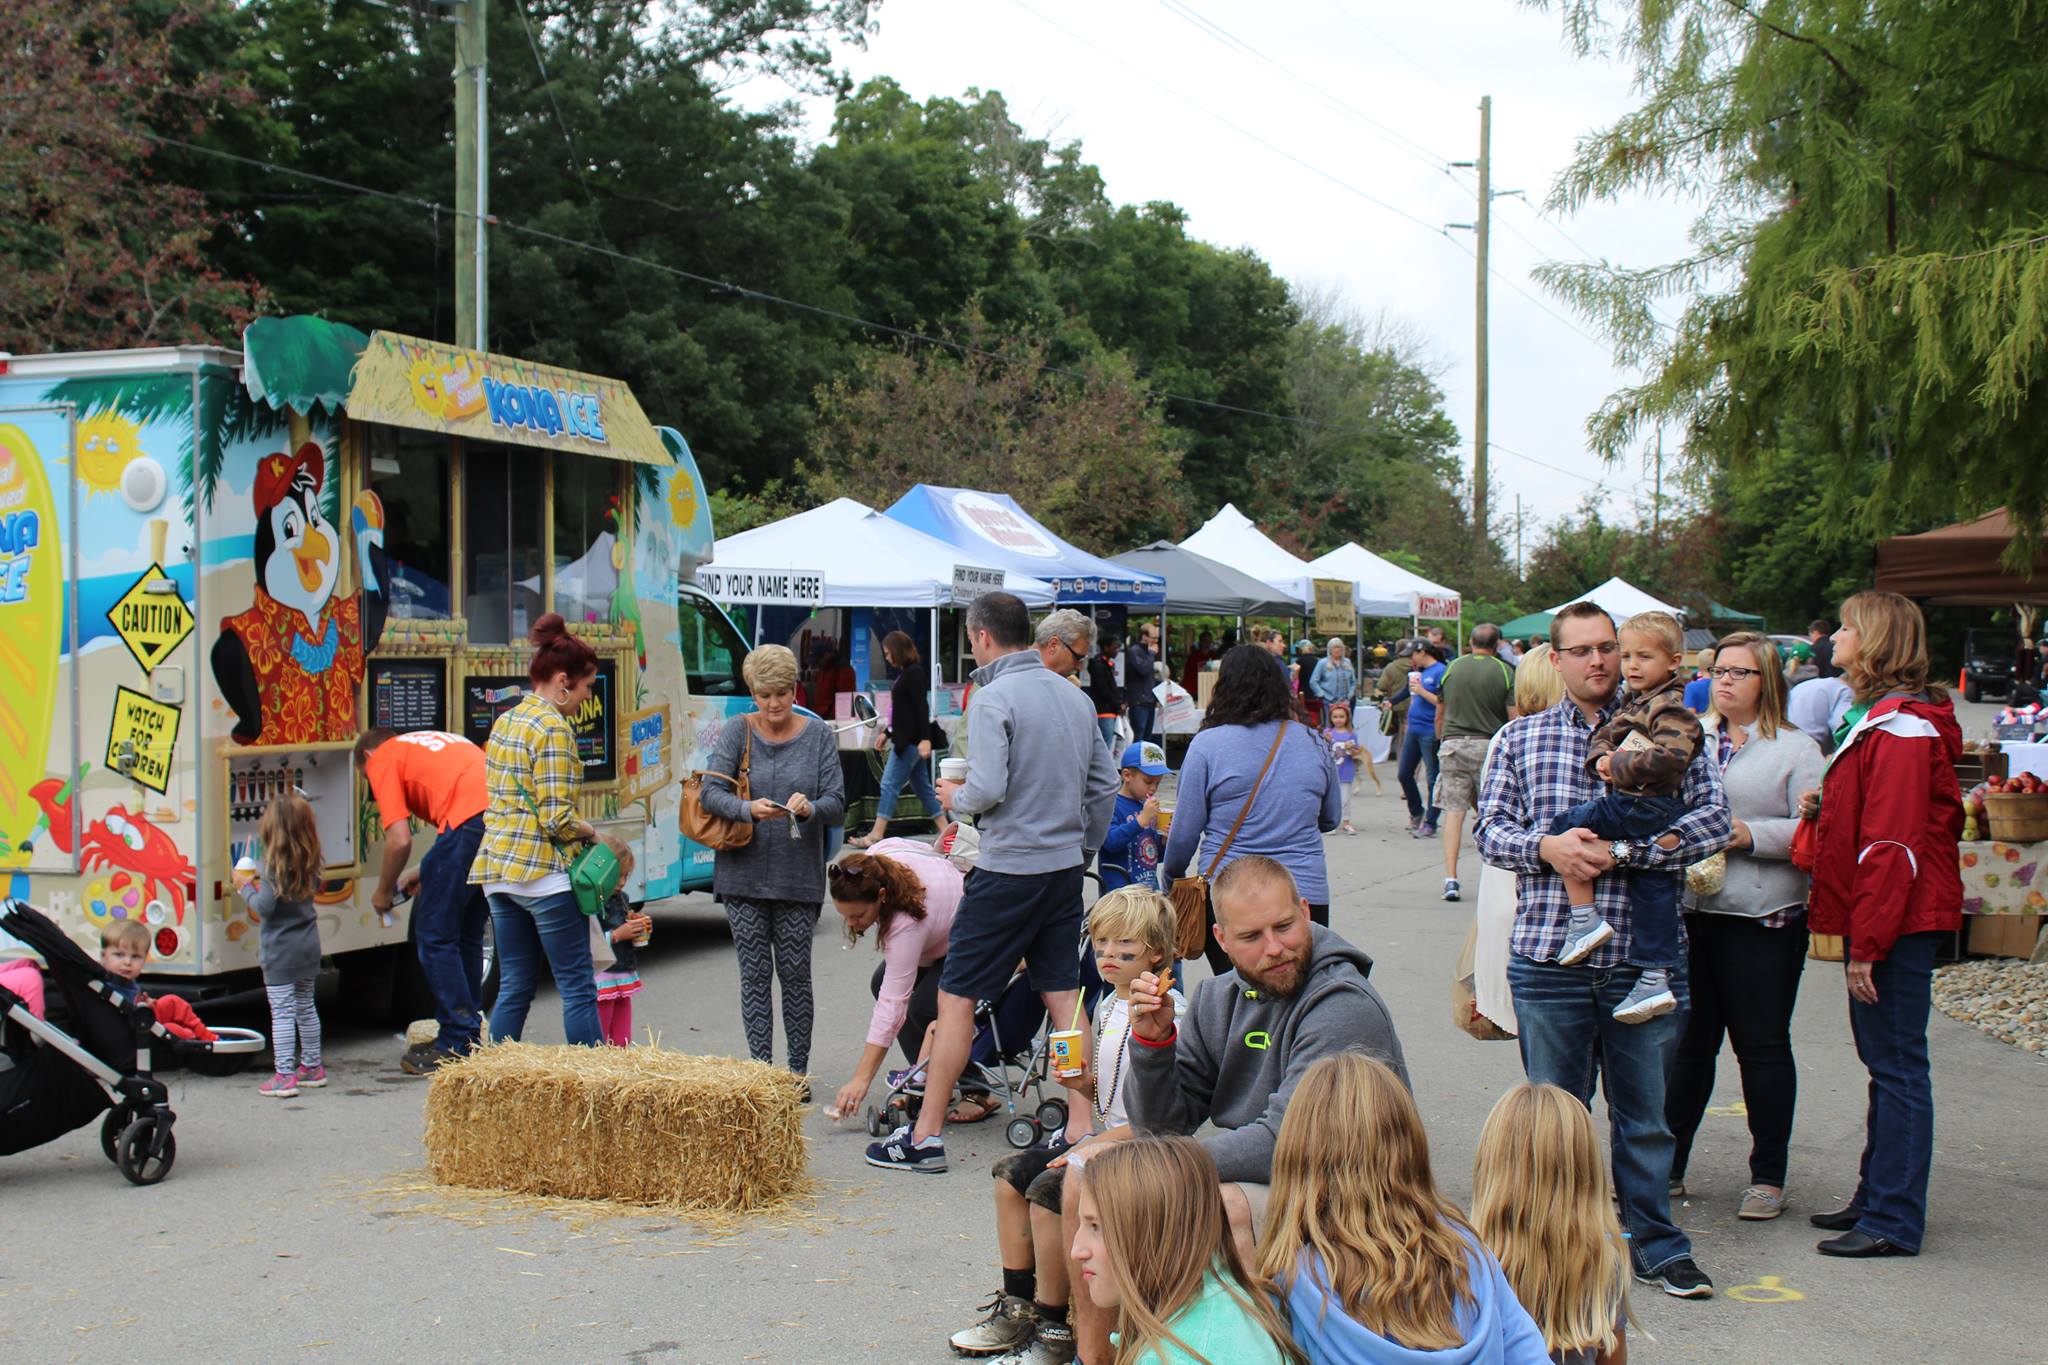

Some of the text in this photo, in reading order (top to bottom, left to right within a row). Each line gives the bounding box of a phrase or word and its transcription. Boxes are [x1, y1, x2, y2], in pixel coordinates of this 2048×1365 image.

[482, 376, 564, 437] KONA
[557, 388, 605, 443] ICE
[726, 573, 753, 597] YOUR
[758, 575, 788, 598] NAME
[793, 576, 819, 599] HERE
[954, 568, 1004, 585] FIND YOUR NAME HERE
[122, 602, 182, 635] CAUTION
[127, 702, 165, 732] WATCH
[631, 712, 663, 748] KONA
[130, 727, 152, 750] FOR
[642, 737, 661, 769] ICE
[111, 741, 164, 780] CDREN
